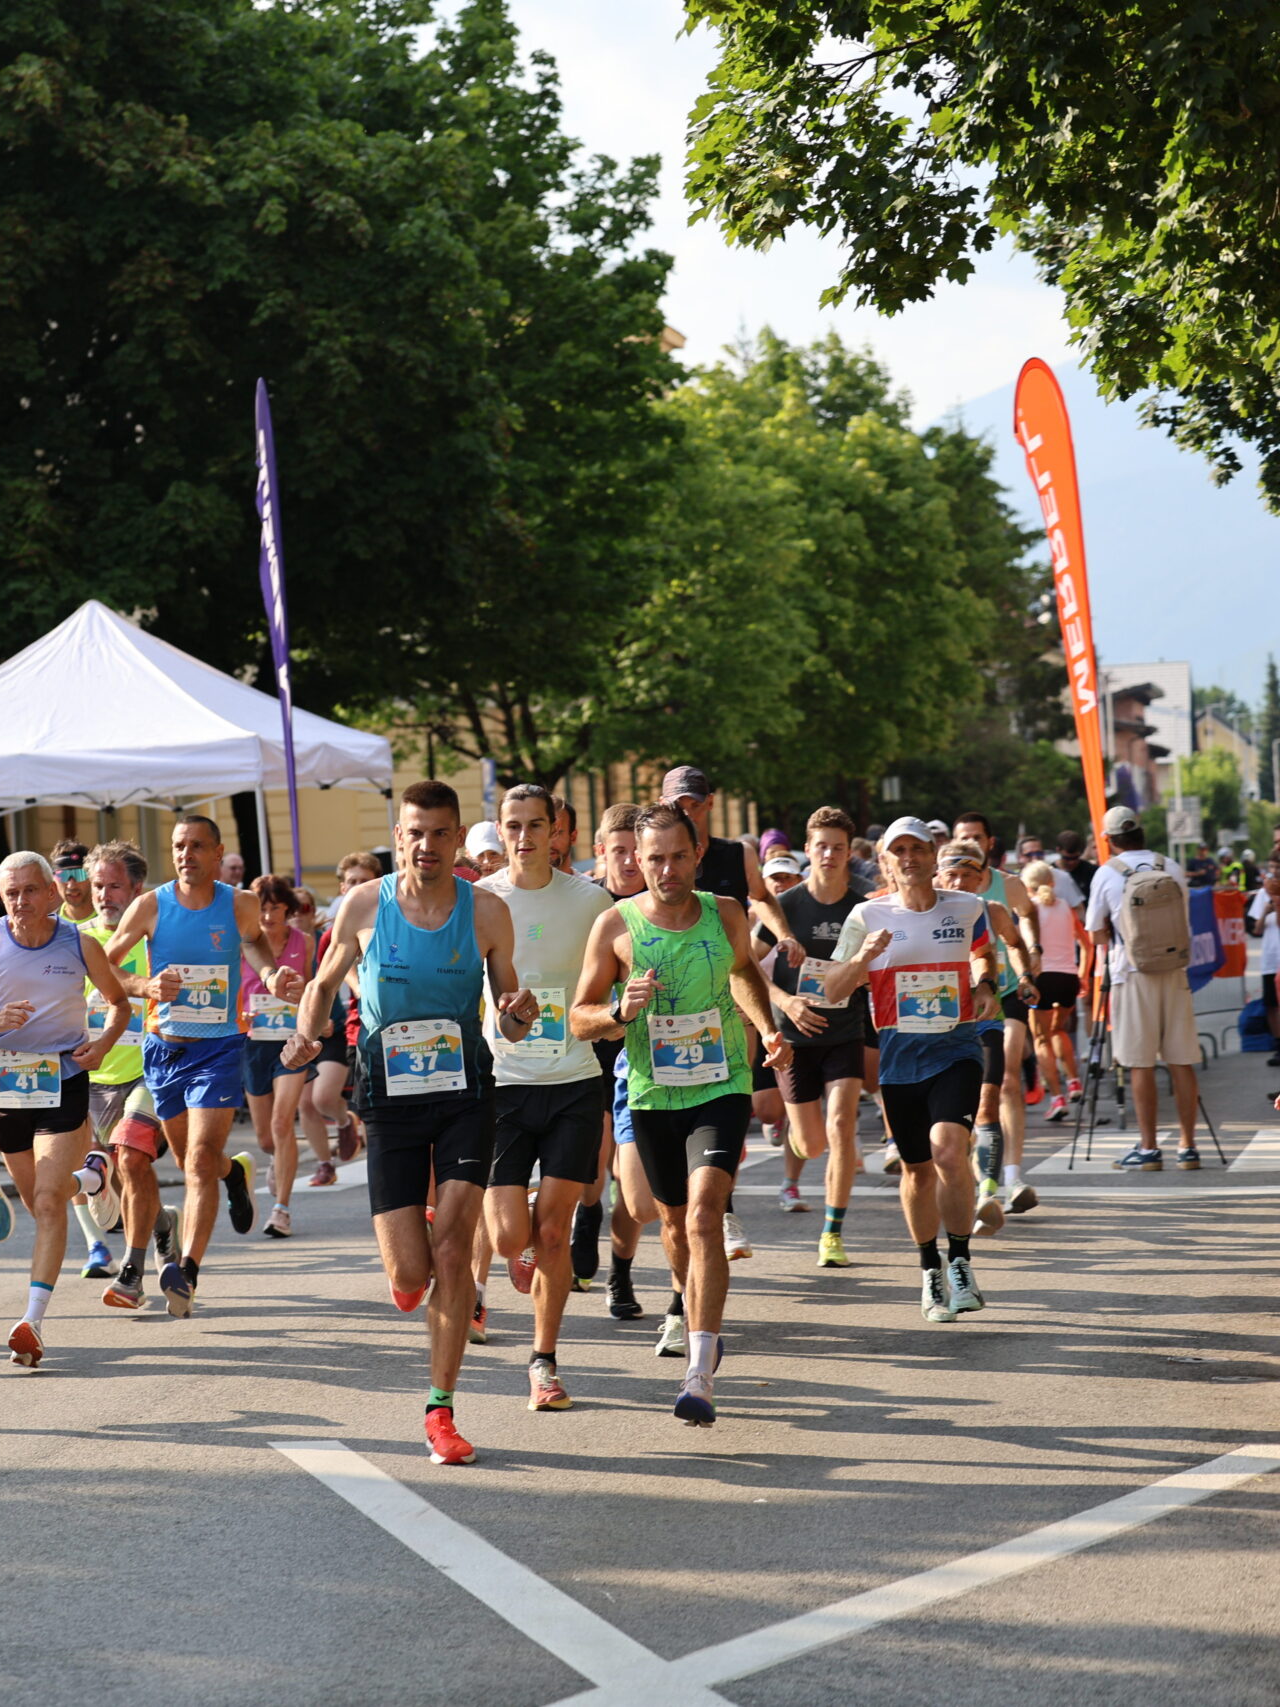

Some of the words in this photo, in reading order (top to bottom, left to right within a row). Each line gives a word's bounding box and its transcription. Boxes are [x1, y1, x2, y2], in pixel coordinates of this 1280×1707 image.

[187, 990, 211, 1006] 40
[916, 998, 942, 1015] 34
[266, 1014, 285, 1026] 74
[409, 1051, 438, 1072] 37
[674, 1045, 703, 1064] 29
[16, 1073, 38, 1089] 41
